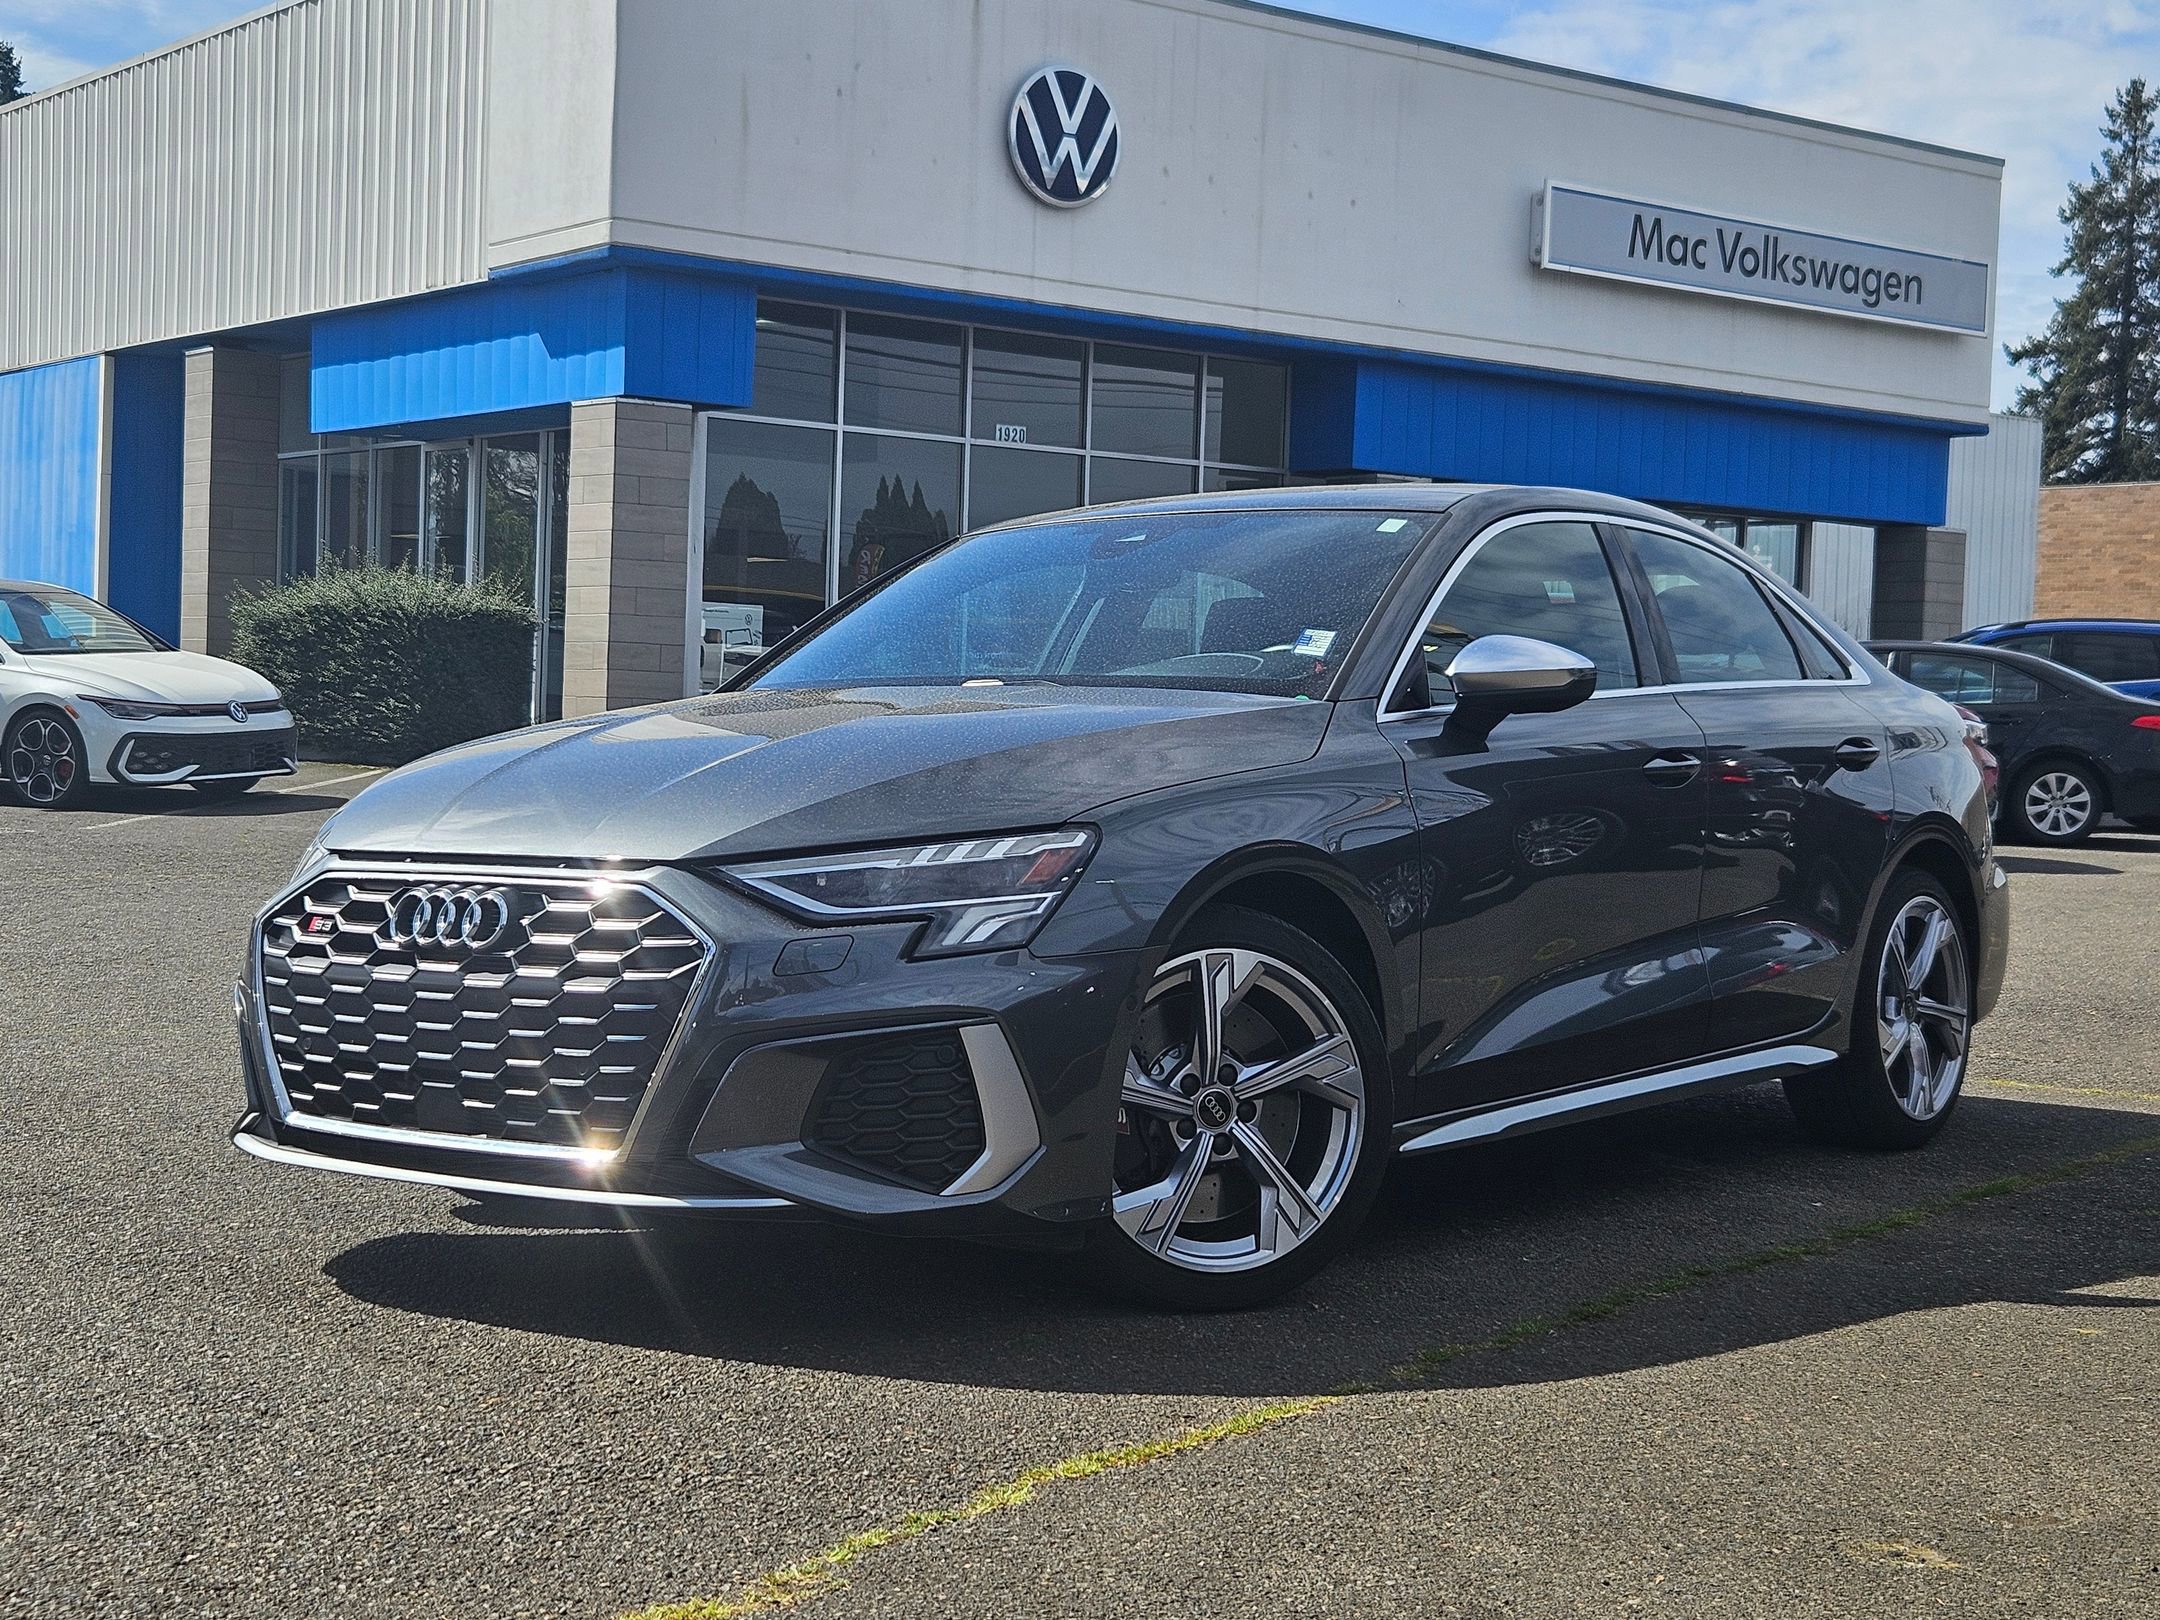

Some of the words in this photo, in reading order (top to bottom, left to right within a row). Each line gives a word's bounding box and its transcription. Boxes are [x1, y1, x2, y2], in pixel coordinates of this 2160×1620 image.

[1014, 68, 1118, 199] VW
[1627, 213, 1707, 270] Mac
[1716, 228, 1922, 308] Volkswagen
[998, 427, 1025, 443] 1920
